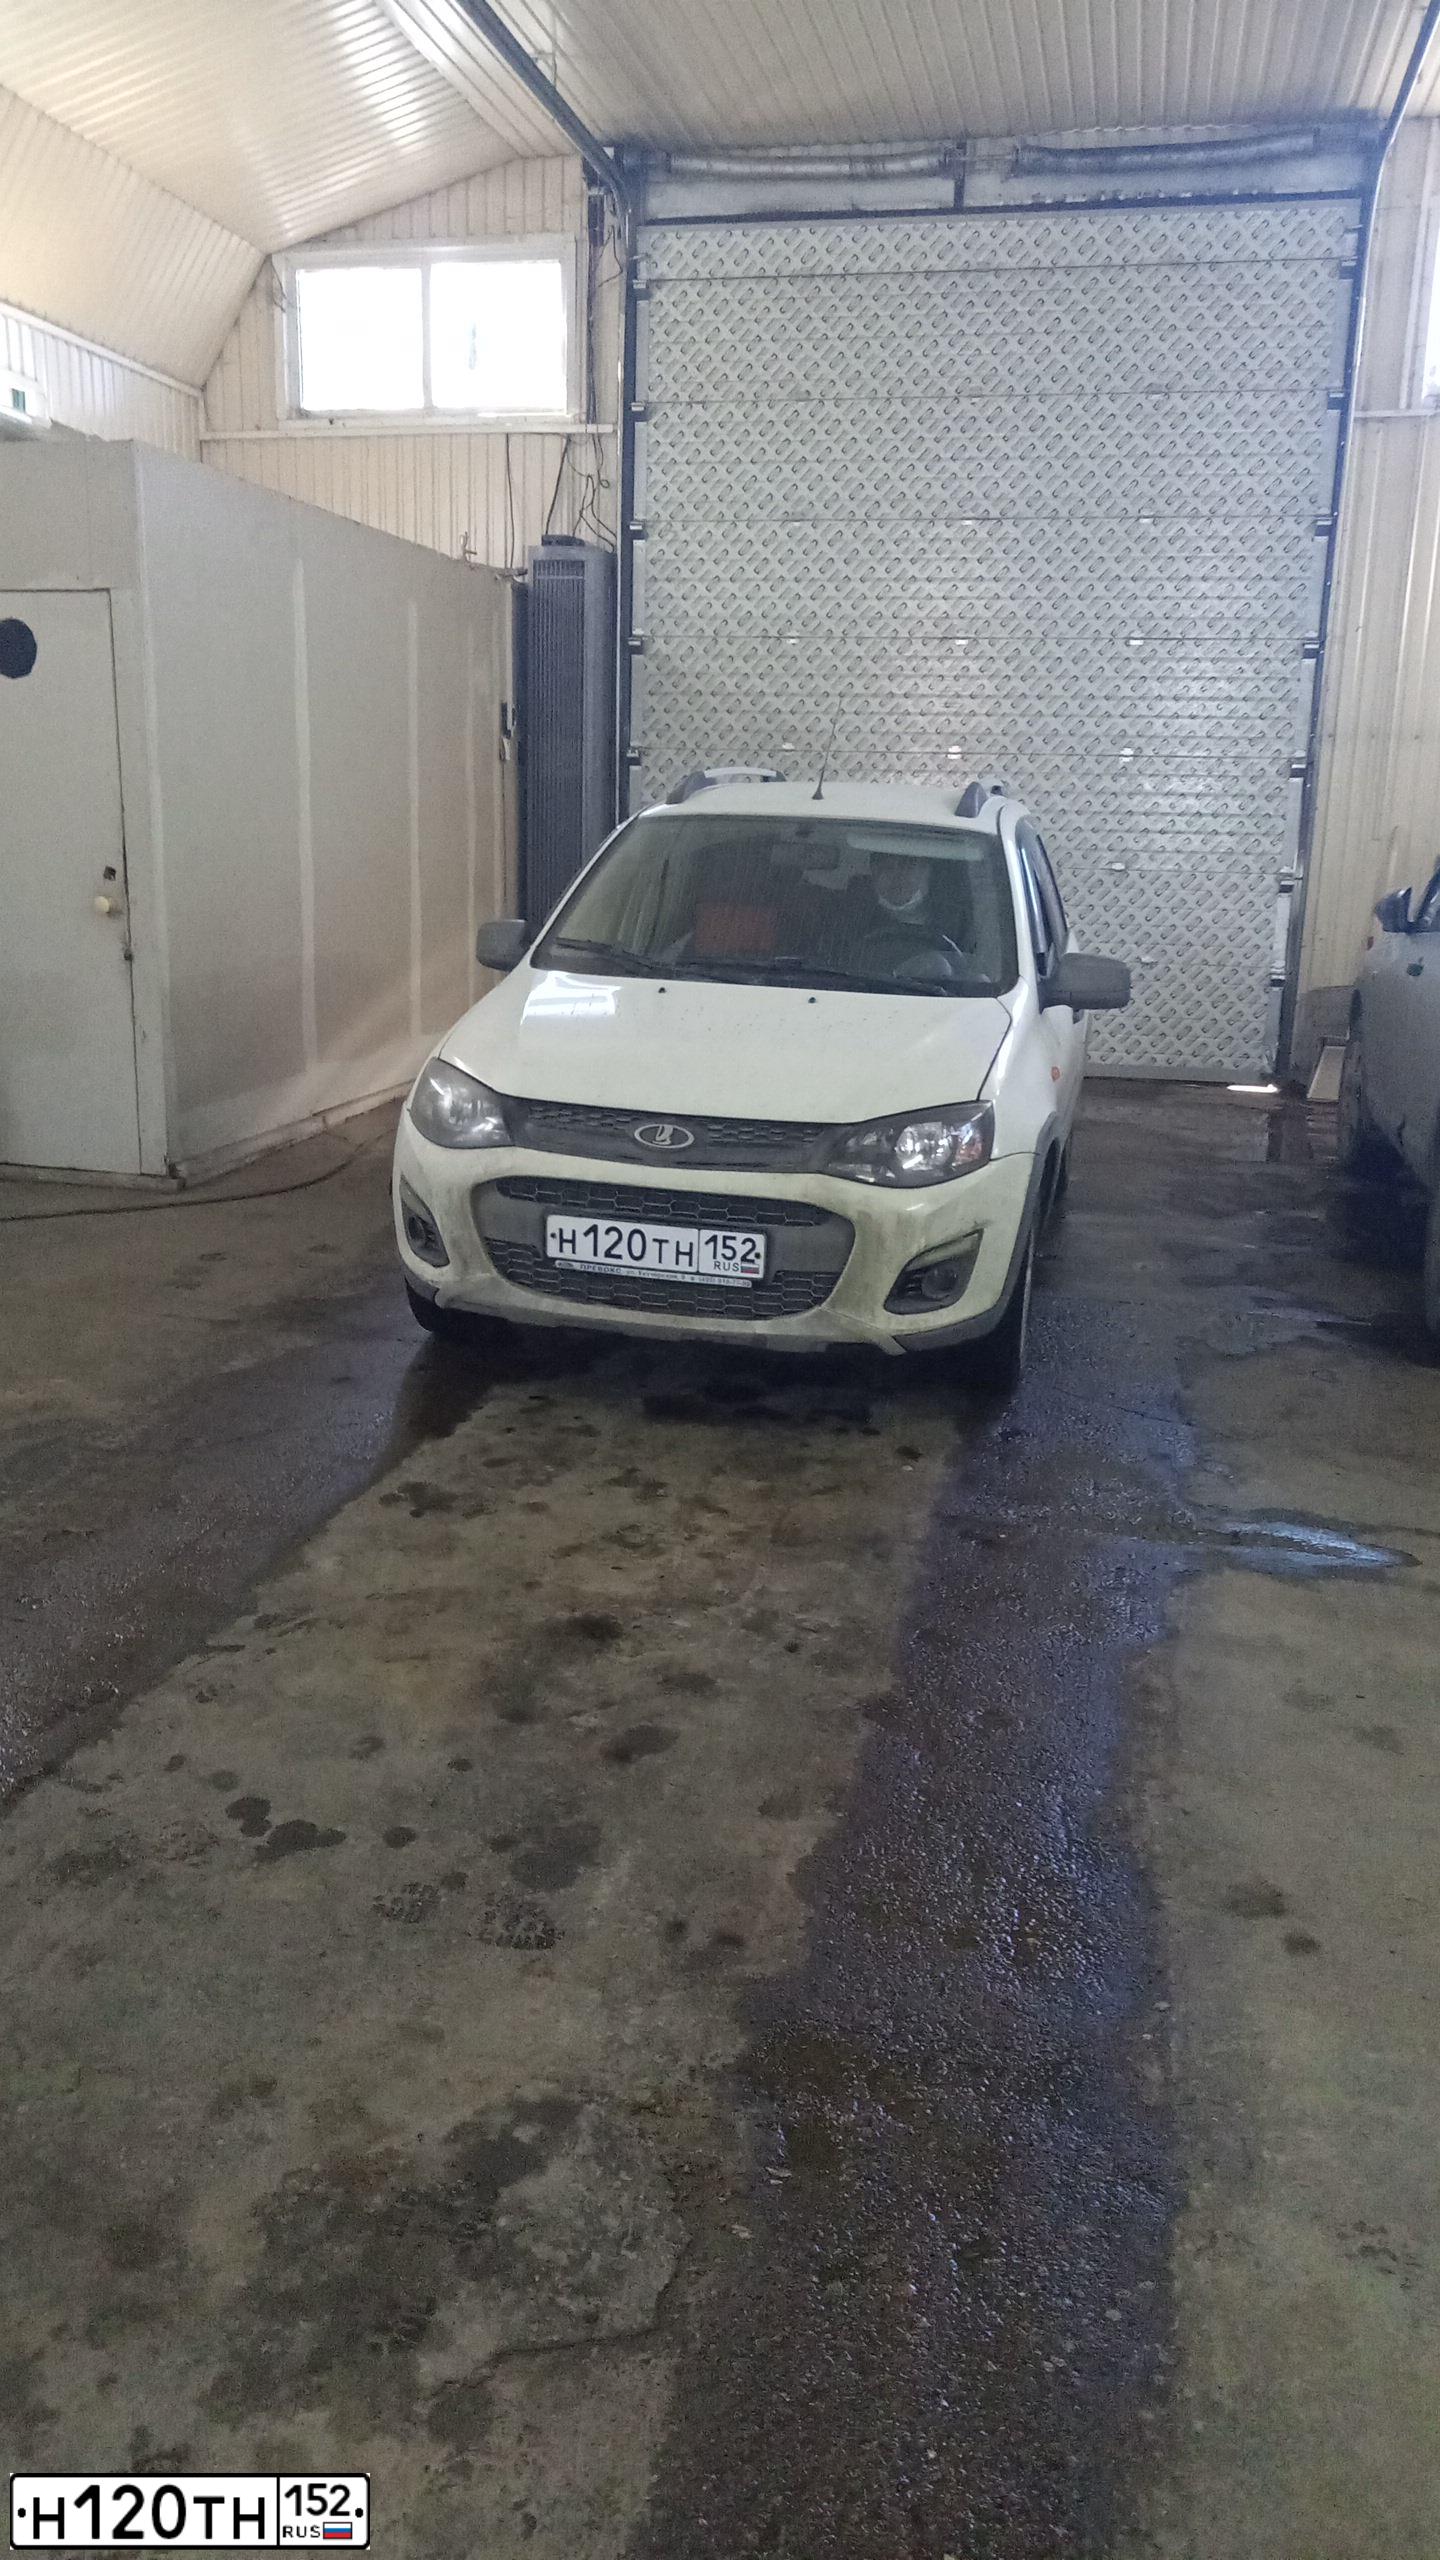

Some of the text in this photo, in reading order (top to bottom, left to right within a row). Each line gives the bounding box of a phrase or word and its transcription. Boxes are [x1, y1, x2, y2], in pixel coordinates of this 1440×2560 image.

[558, 1223, 757, 1267] Н120ТН 152
[713, 1260, 740, 1272] RUS
